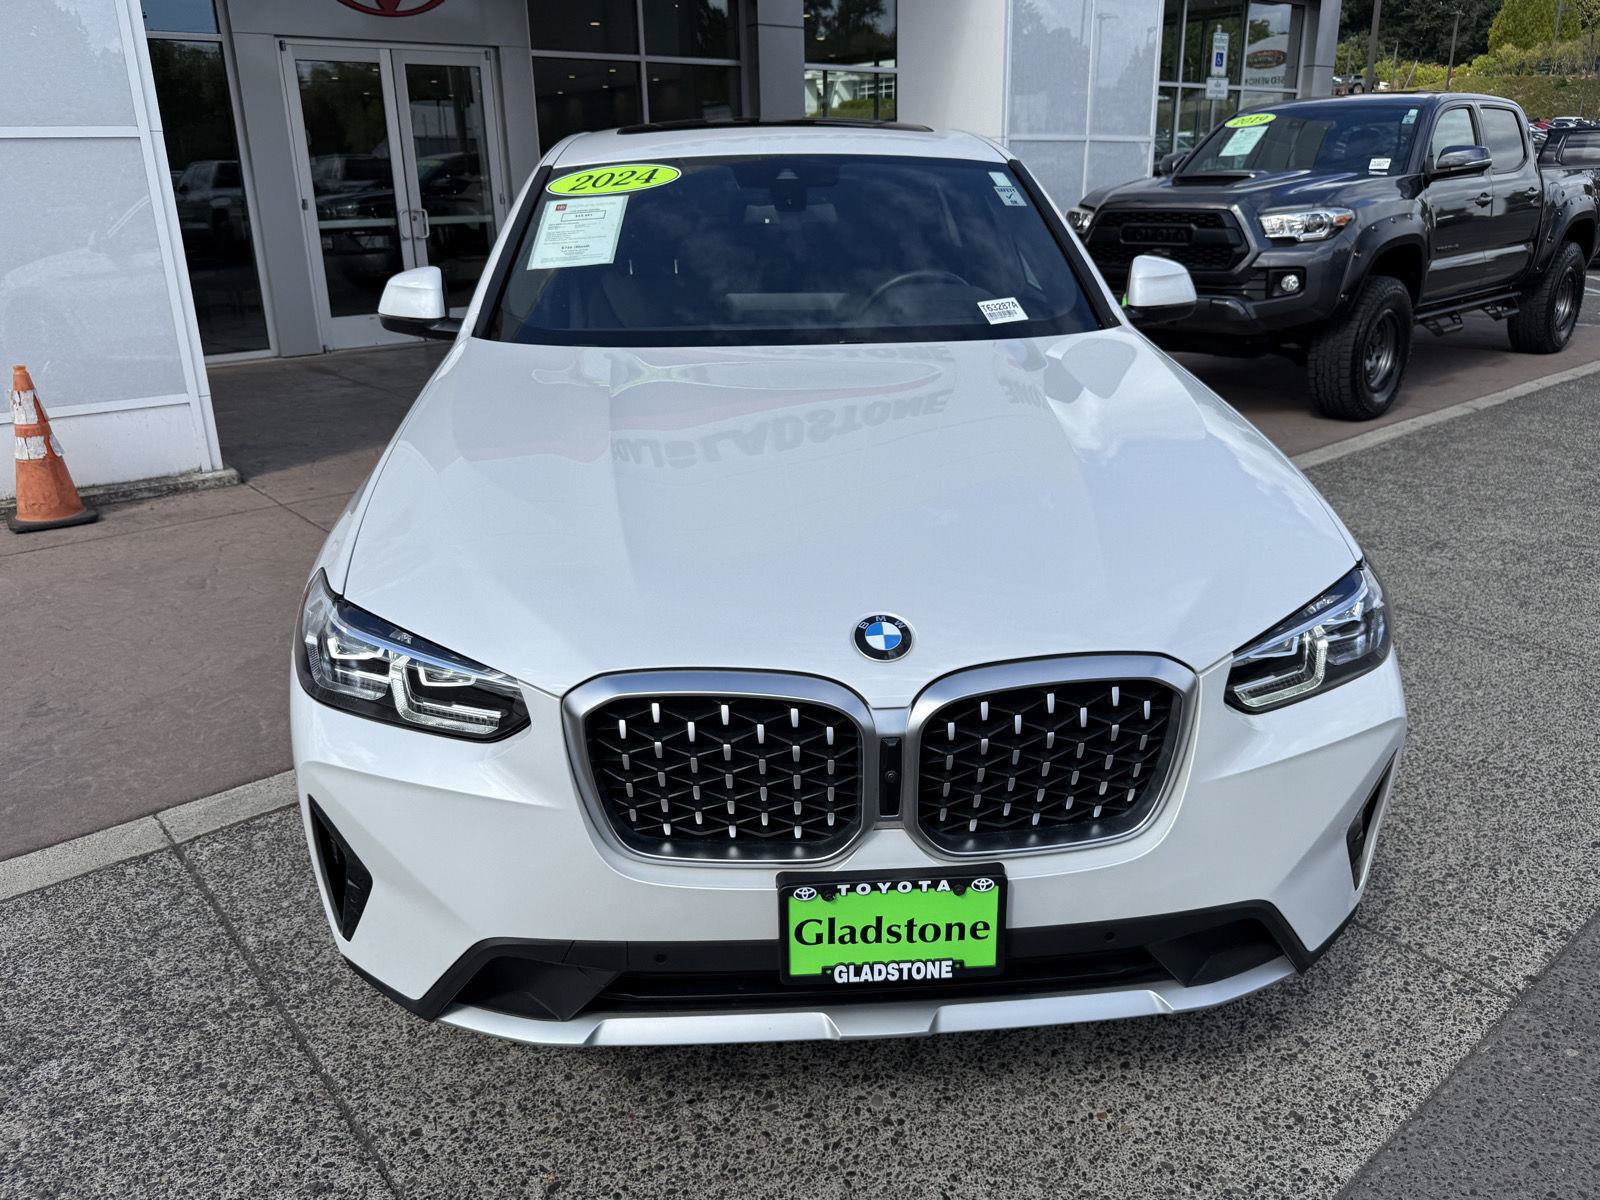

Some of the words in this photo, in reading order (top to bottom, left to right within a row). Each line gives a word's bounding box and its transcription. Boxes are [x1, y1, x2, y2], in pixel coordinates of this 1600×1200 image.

[568, 168, 658, 192] 2024
[1126, 227, 1189, 241] TOYOTA
[980, 301, 1019, 313] T63287A
[858, 615, 906, 629] BMW
[837, 880, 951, 896] TOYOTA
[794, 915, 991, 946] Gladstone
[833, 960, 953, 984] GLADSTONE
